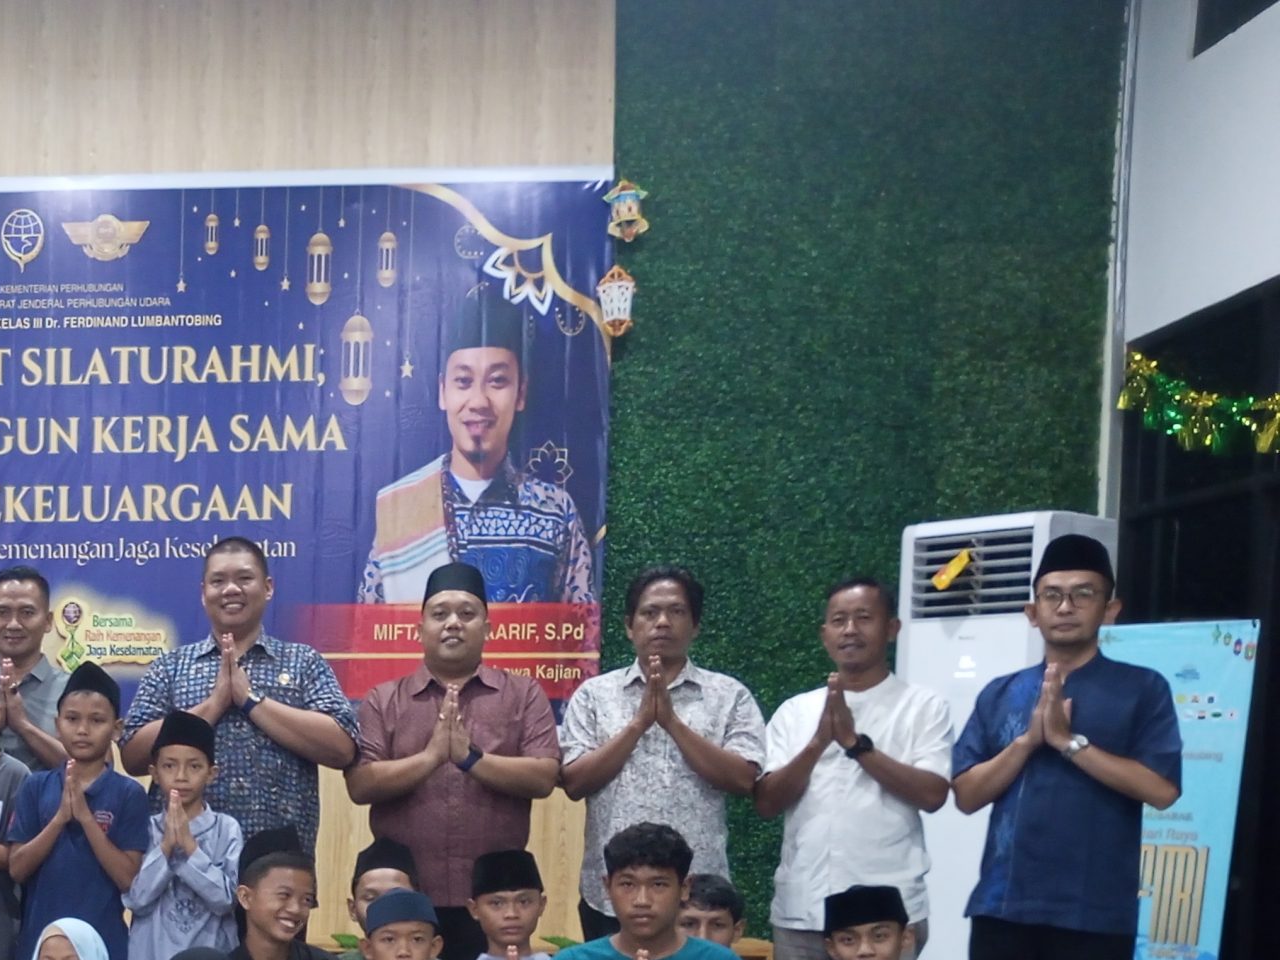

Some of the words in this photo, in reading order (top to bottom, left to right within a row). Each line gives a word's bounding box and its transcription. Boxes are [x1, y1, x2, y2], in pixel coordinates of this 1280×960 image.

[0, 284, 58, 294] KEMENTERIAN
[60, 283, 124, 293] PERHUBUNGAN
[18, 298, 64, 309] JENDERAL
[67, 297, 138, 308] PERHUBUNGAN
[139, 297, 171, 307] UDARA
[33, 317, 43, 328] III
[45, 317, 61, 328] Dr.
[63, 316, 129, 328] FERDINAND
[131, 314, 222, 327] LUMBANTOBING
[91, 414, 220, 462] KERJA
[229, 413, 347, 452] SAMA
[115, 536, 160, 566] Jaga
[92, 614, 133, 627] Bersama
[85, 629, 104, 641] Raih
[544, 623, 584, 641] S.Pd
[86, 644, 107, 659] Jaga
[109, 643, 163, 656] Keselamatan
[535, 663, 581, 683] Kajian
